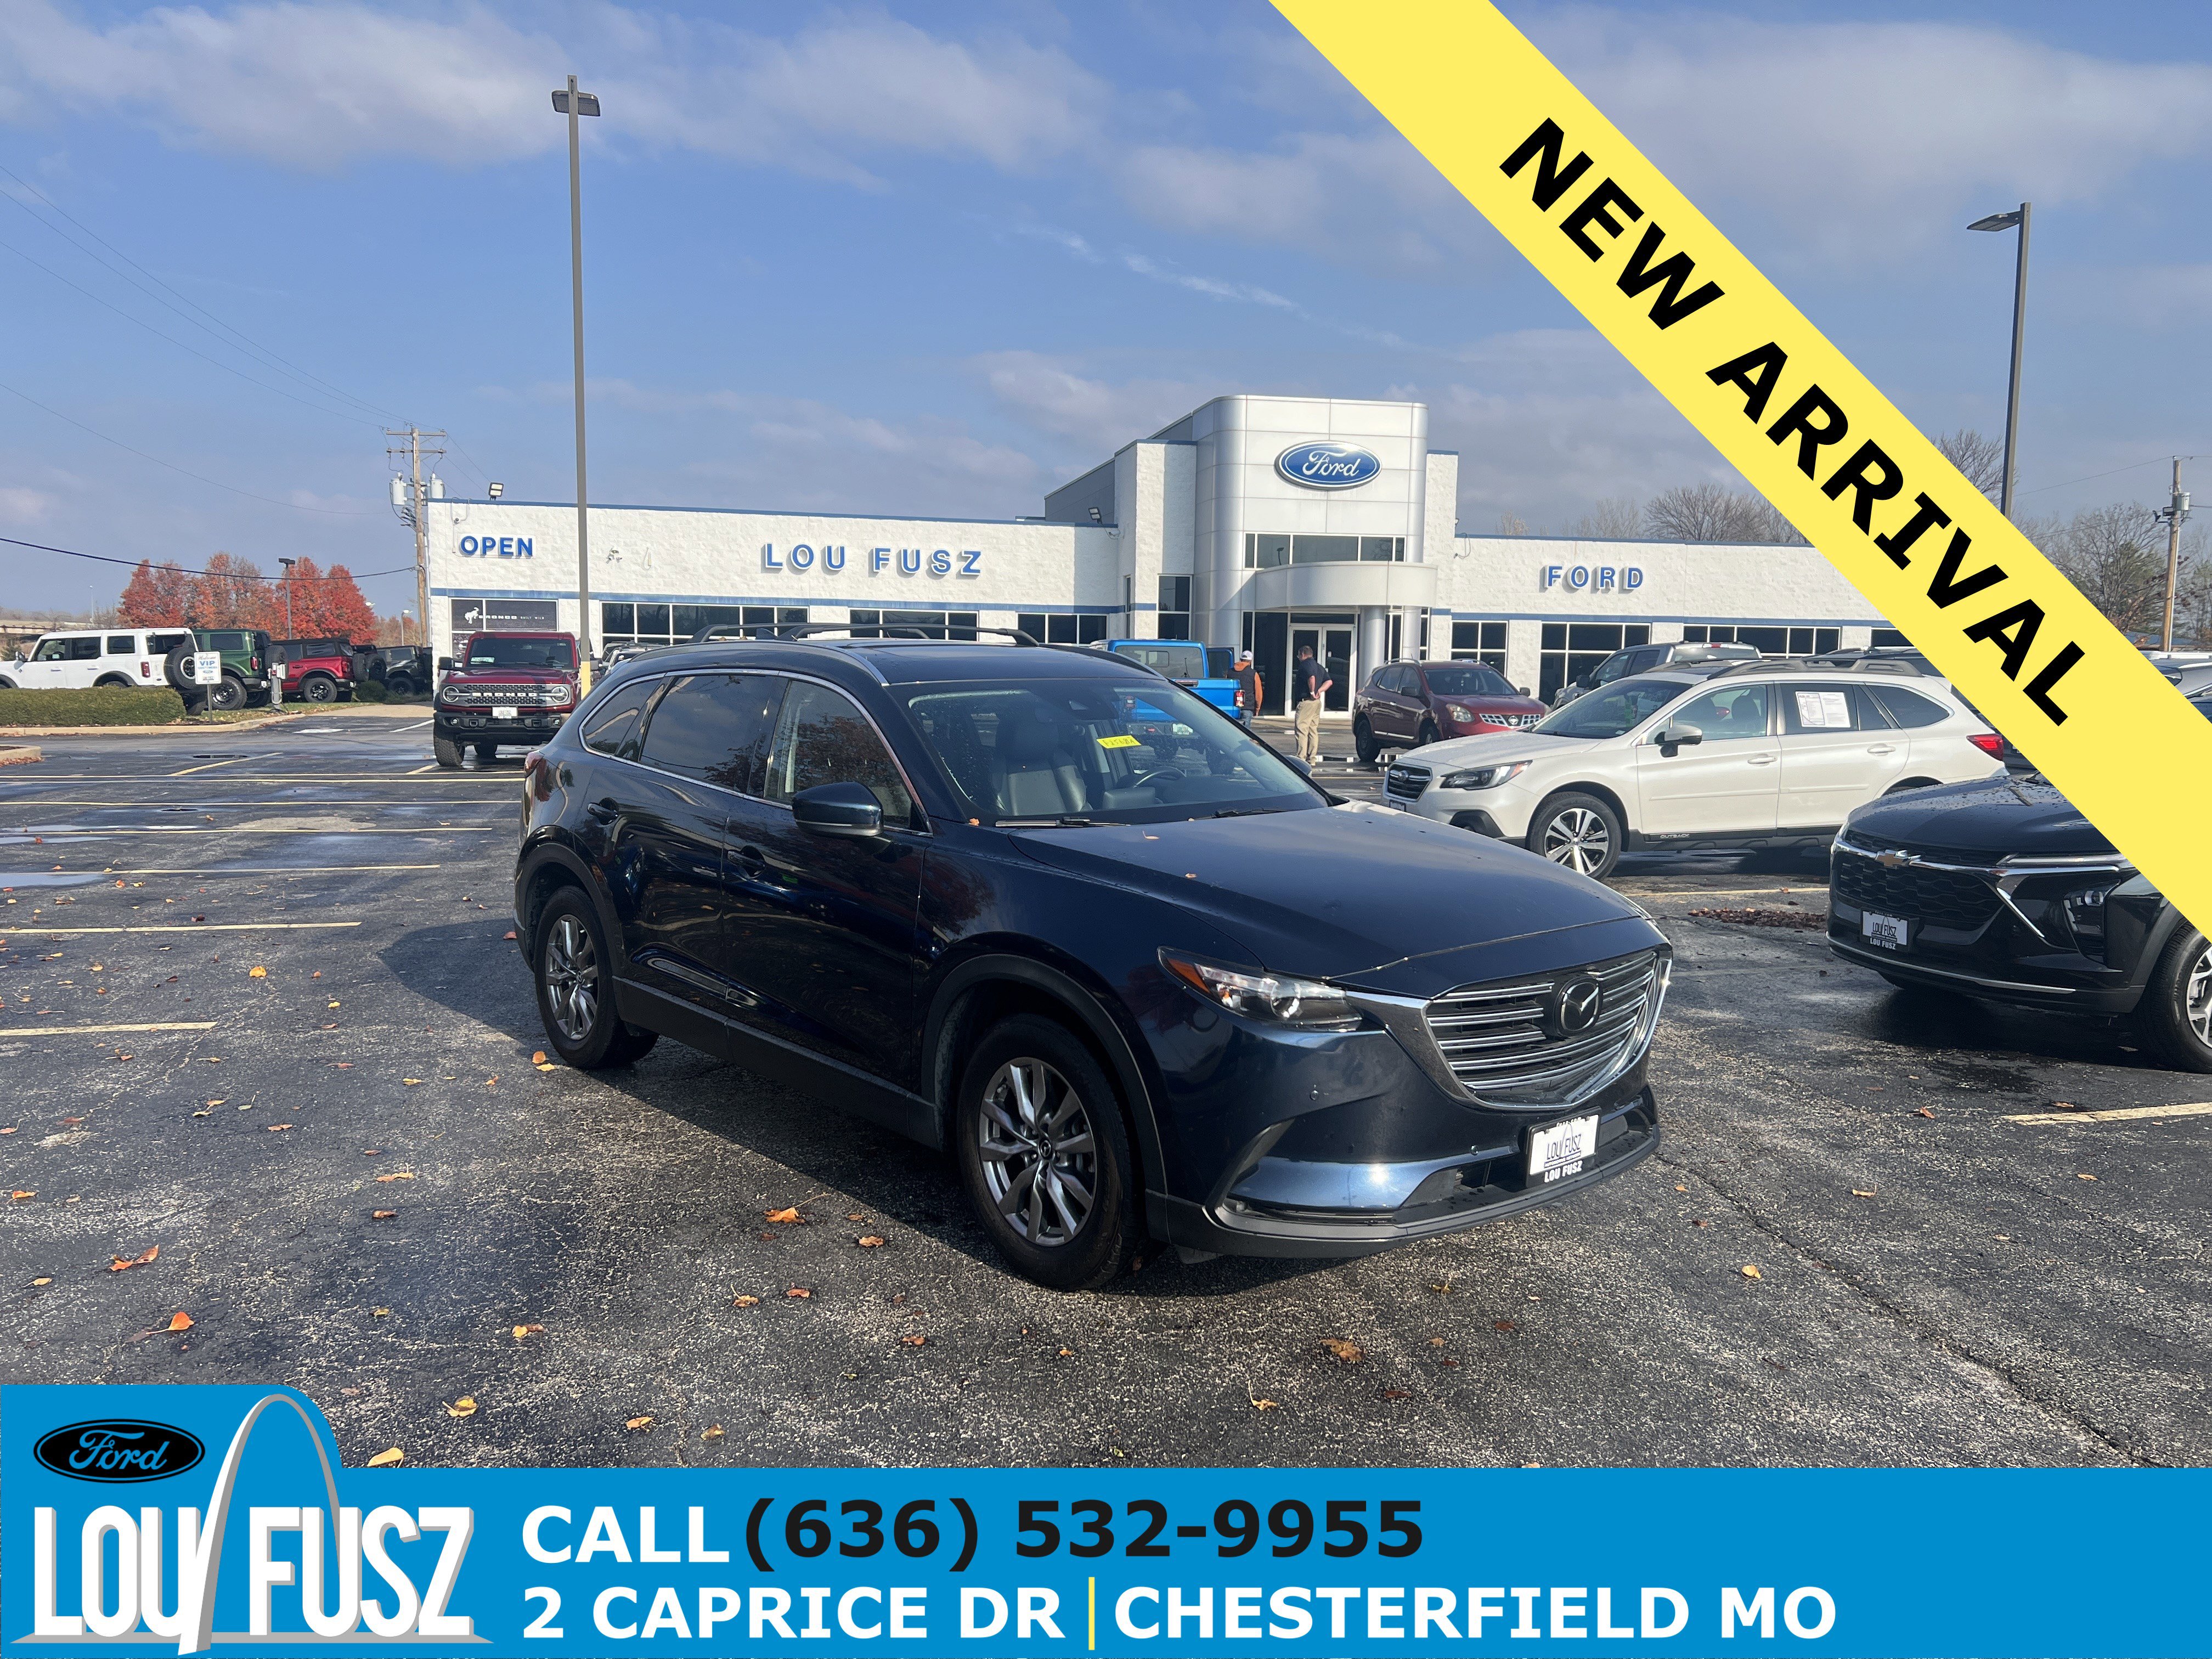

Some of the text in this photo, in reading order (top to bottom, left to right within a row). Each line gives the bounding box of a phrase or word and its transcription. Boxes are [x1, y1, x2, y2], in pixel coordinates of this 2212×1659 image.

[1302, 450, 1361, 477] Ford
[460, 535, 533, 557] OPEN
[765, 544, 981, 574] LOU FUSZ
[1547, 566, 1644, 590] FORD
[1872, 922, 1897, 937] LOU FUSZ
[1870, 937, 1881, 946] LOU
[1882, 941, 1896, 950] FUSZ
[1547, 1141, 1562, 1160] LOU
[1564, 1133, 1581, 1155] FUSZ
[1544, 1160, 1583, 1183] LOU FUSZ
